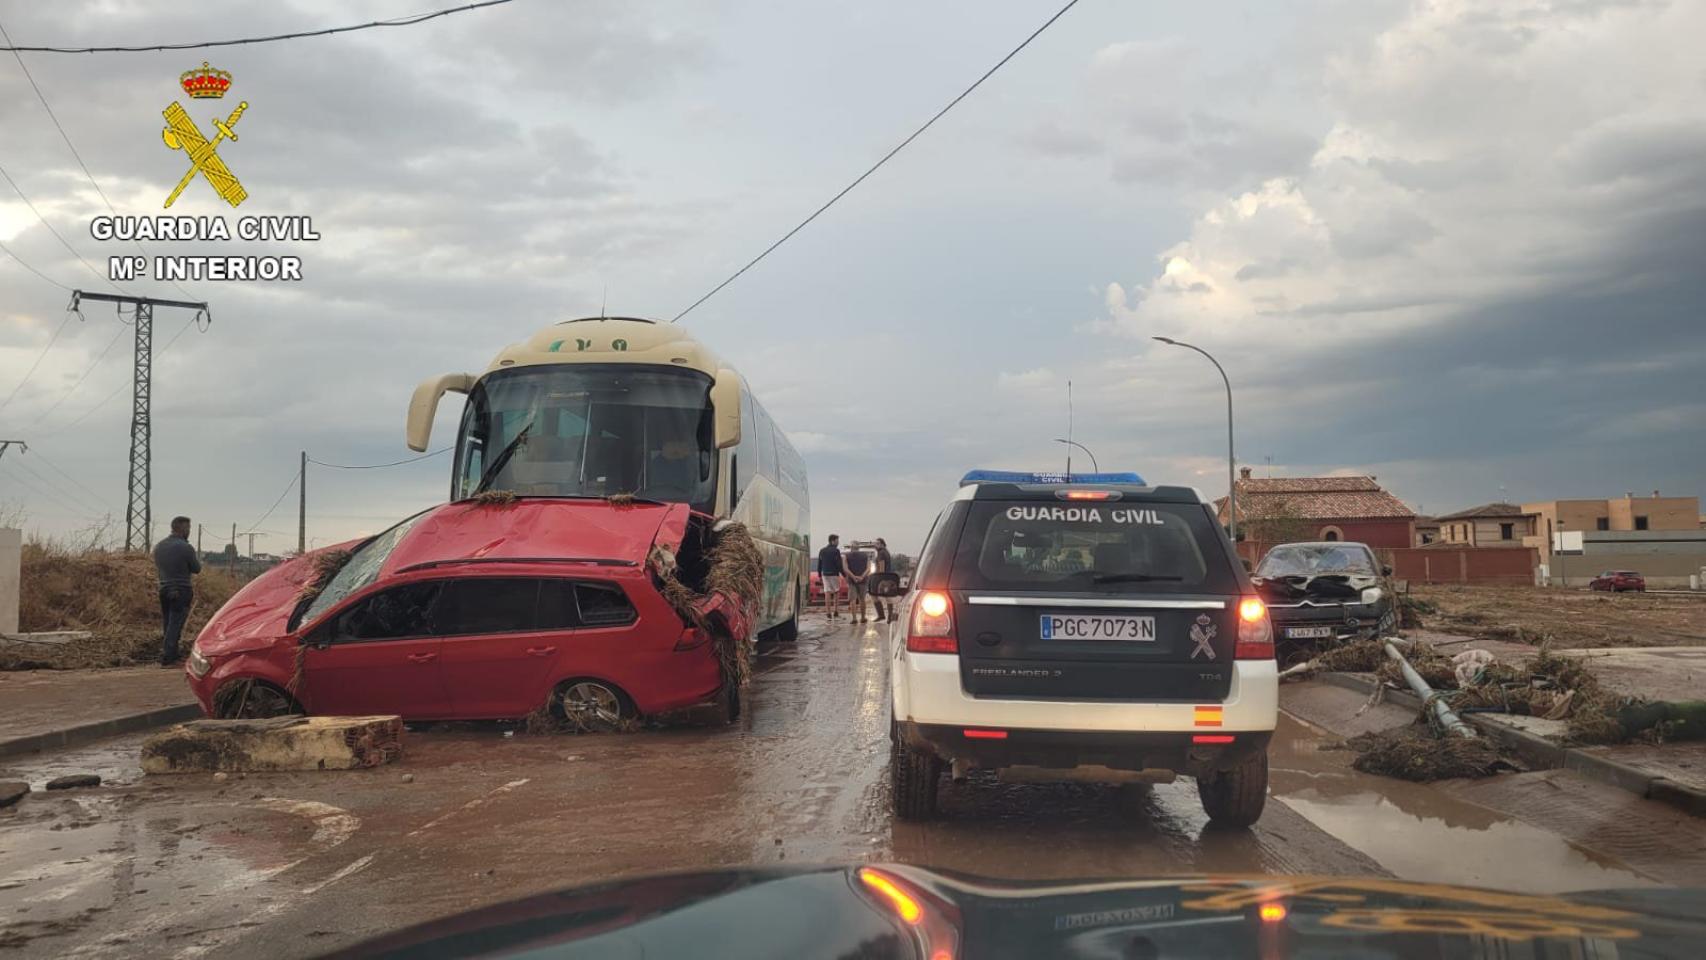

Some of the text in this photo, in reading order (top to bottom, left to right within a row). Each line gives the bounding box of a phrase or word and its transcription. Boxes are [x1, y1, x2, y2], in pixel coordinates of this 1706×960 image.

[1006, 507, 1164, 525] GUARDIA CIVIL
[972, 668, 1049, 678] FREELANDER
